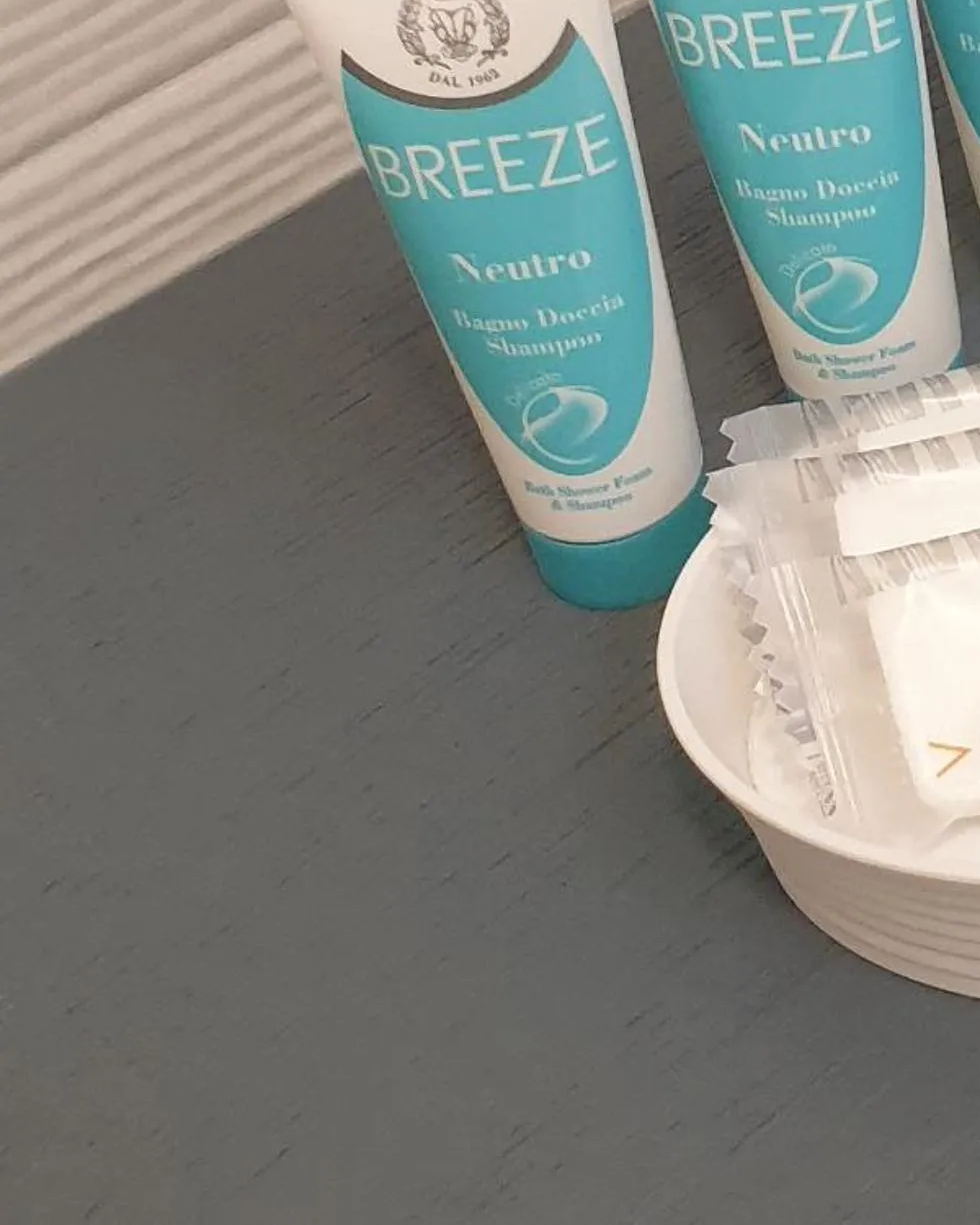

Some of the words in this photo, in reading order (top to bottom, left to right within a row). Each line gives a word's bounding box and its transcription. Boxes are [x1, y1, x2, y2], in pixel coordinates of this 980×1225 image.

[428, 71, 463, 88] DAL
[737, 122, 873, 155] Neutro
[366, 113, 618, 201] BREEZE
[734, 178, 808, 202] Bagno
[816, 169, 900, 200] Doccia
[765, 203, 877, 229] Shampoo
[449, 247, 593, 283] Neutro
[452, 308, 529, 333] Bagno
[536, 292, 626, 328] Doccia
[486, 331, 603, 358] Shampoo
